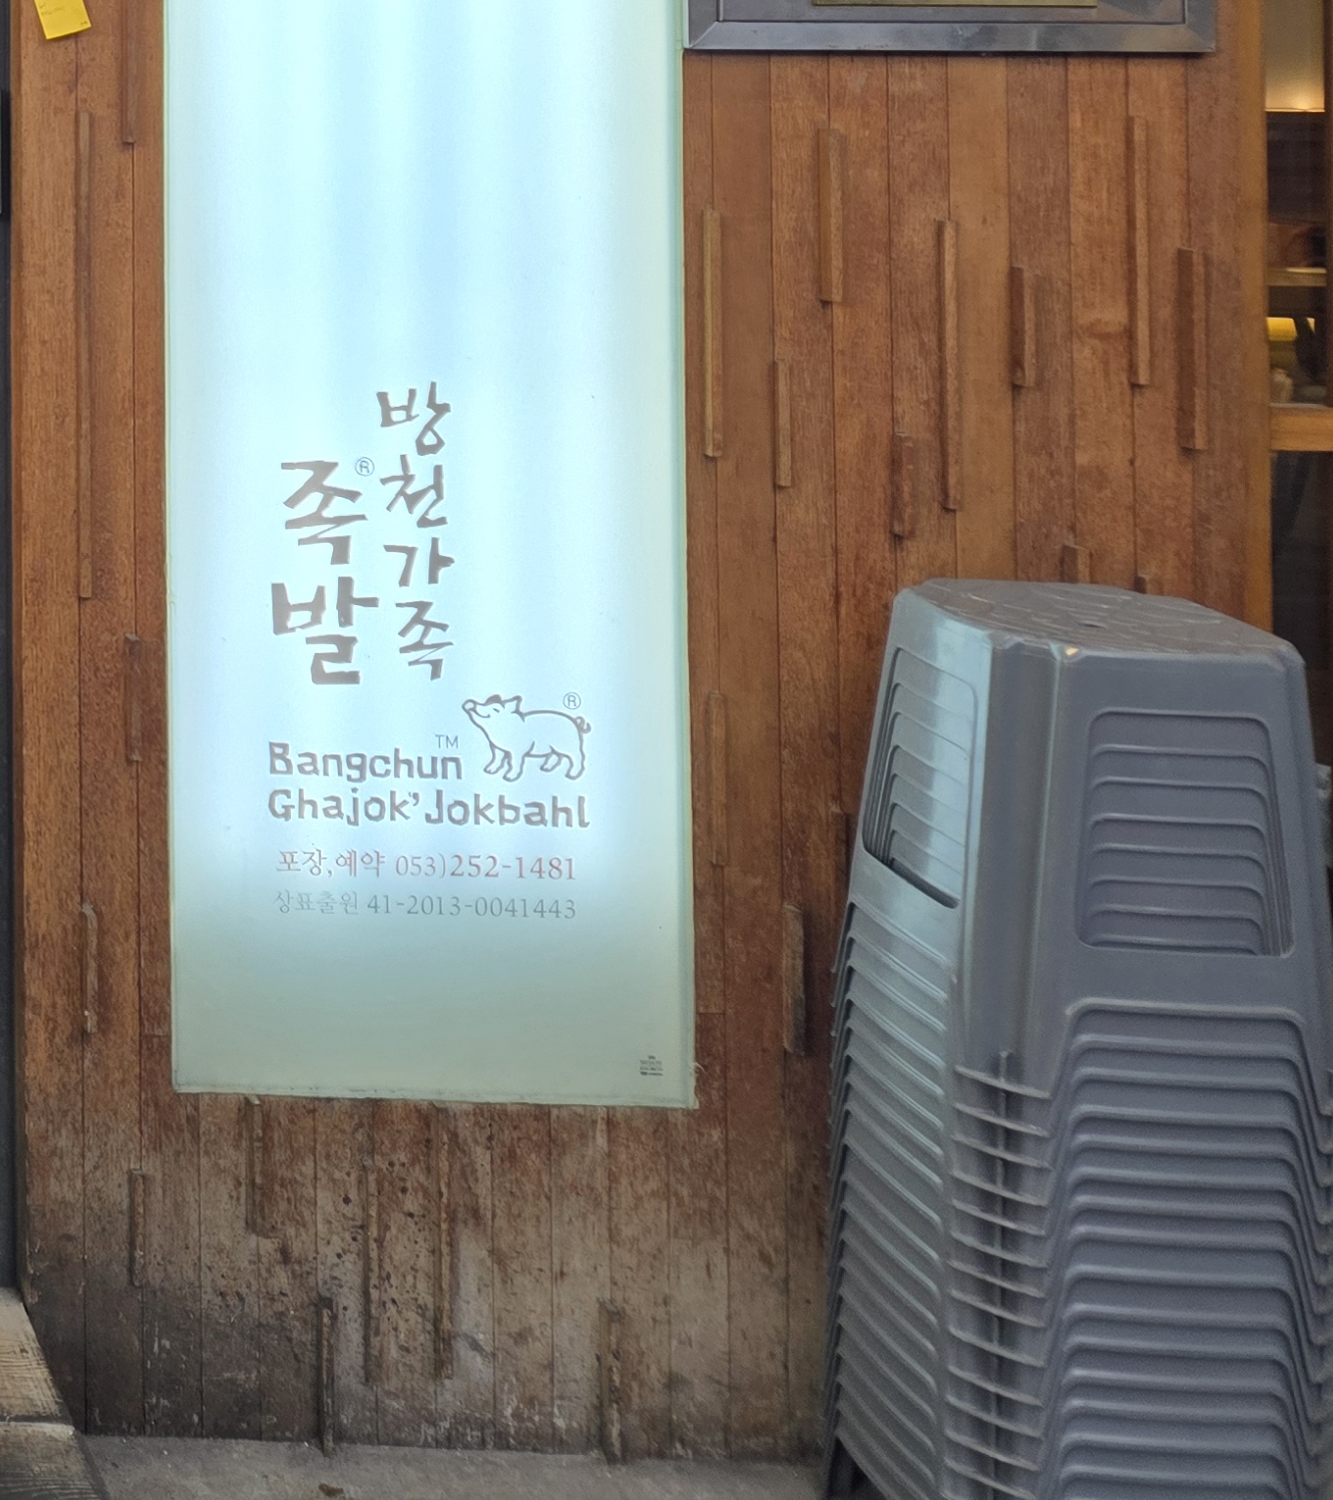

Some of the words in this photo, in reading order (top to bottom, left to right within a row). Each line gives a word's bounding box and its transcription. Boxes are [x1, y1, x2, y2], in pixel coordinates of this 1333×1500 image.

[270, 460, 380, 685] 족발
[376, 380, 455, 682] 방천가족
[268, 741, 463, 783] Bangchun
[274, 889, 359, 915] 상표출원
[367, 892, 577, 919] 41-2013-0041443
